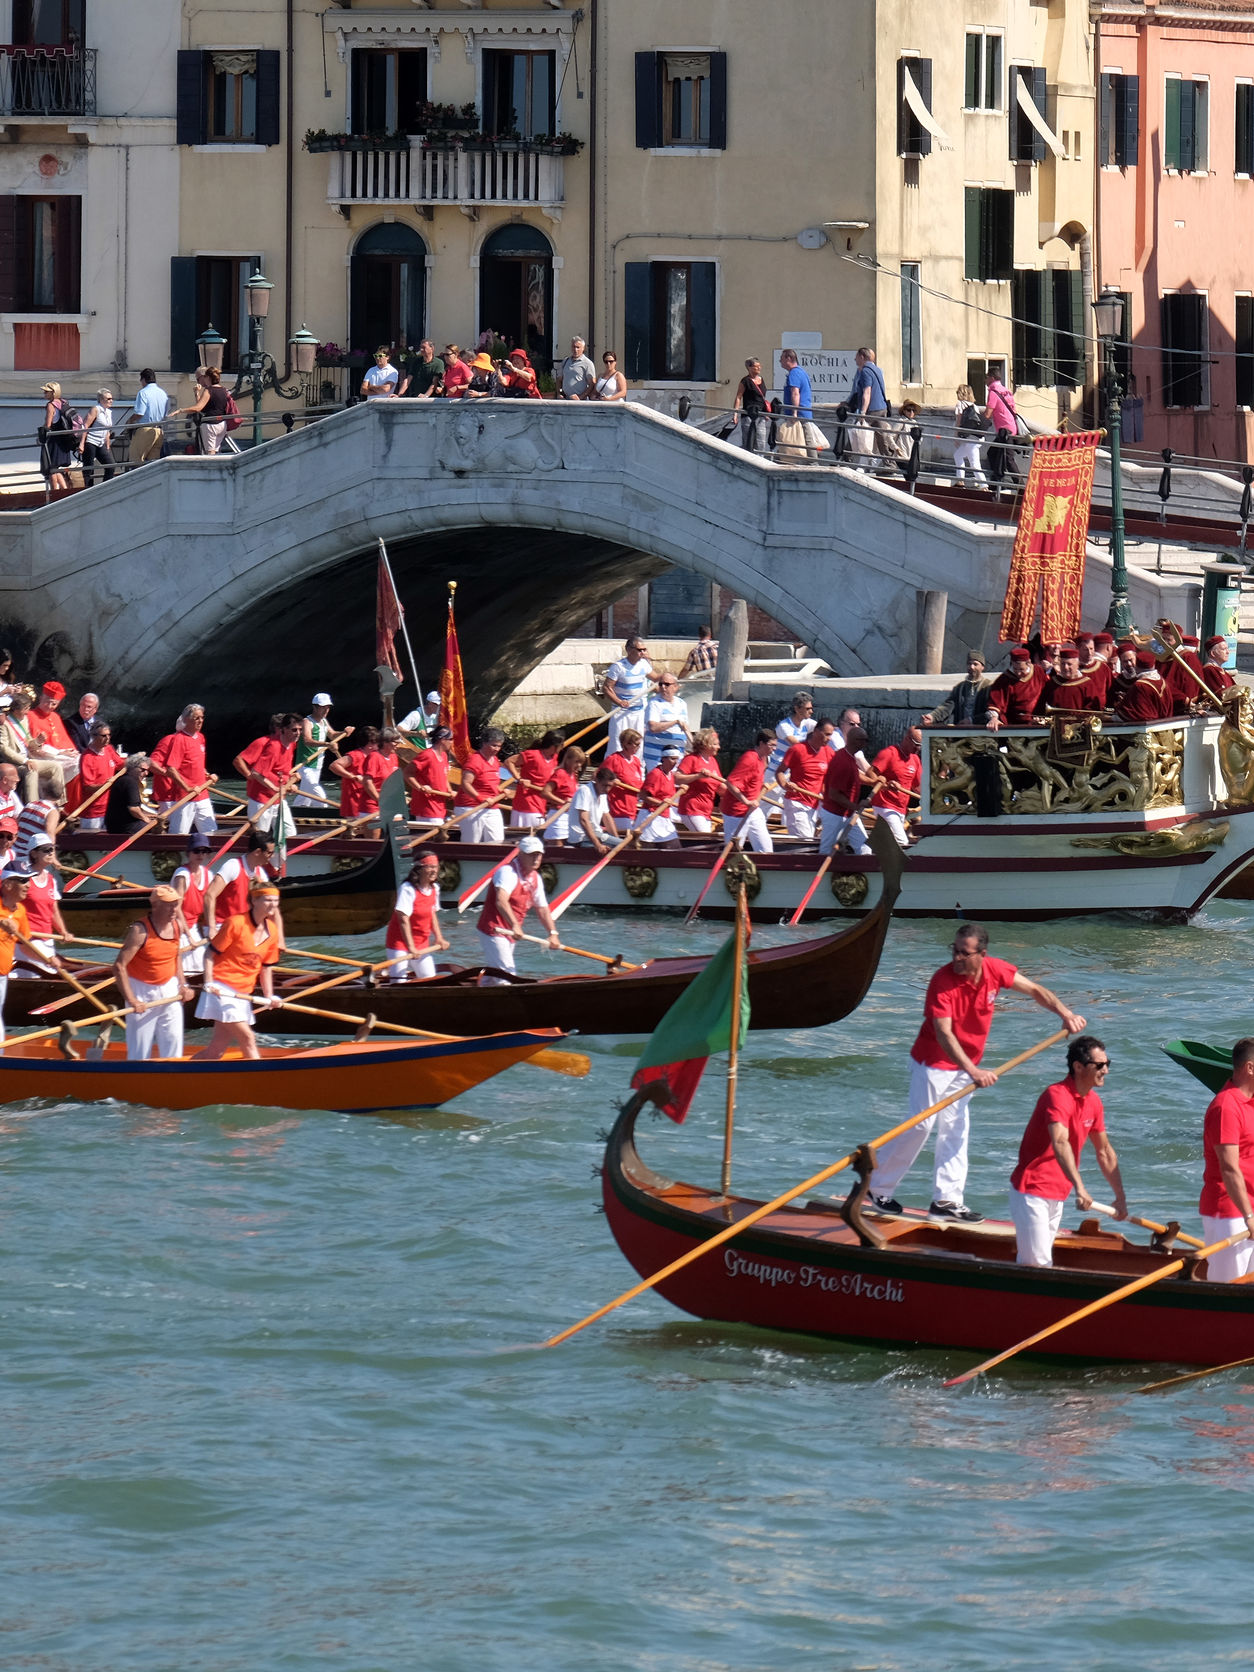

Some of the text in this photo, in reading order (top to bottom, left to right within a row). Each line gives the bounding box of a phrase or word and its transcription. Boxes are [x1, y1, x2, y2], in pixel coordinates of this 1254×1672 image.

[801, 357, 849, 367] ROCHIA
[810, 373, 849, 384] ARTIN
[724, 1249, 905, 1303] Gruppo Tre Archi
